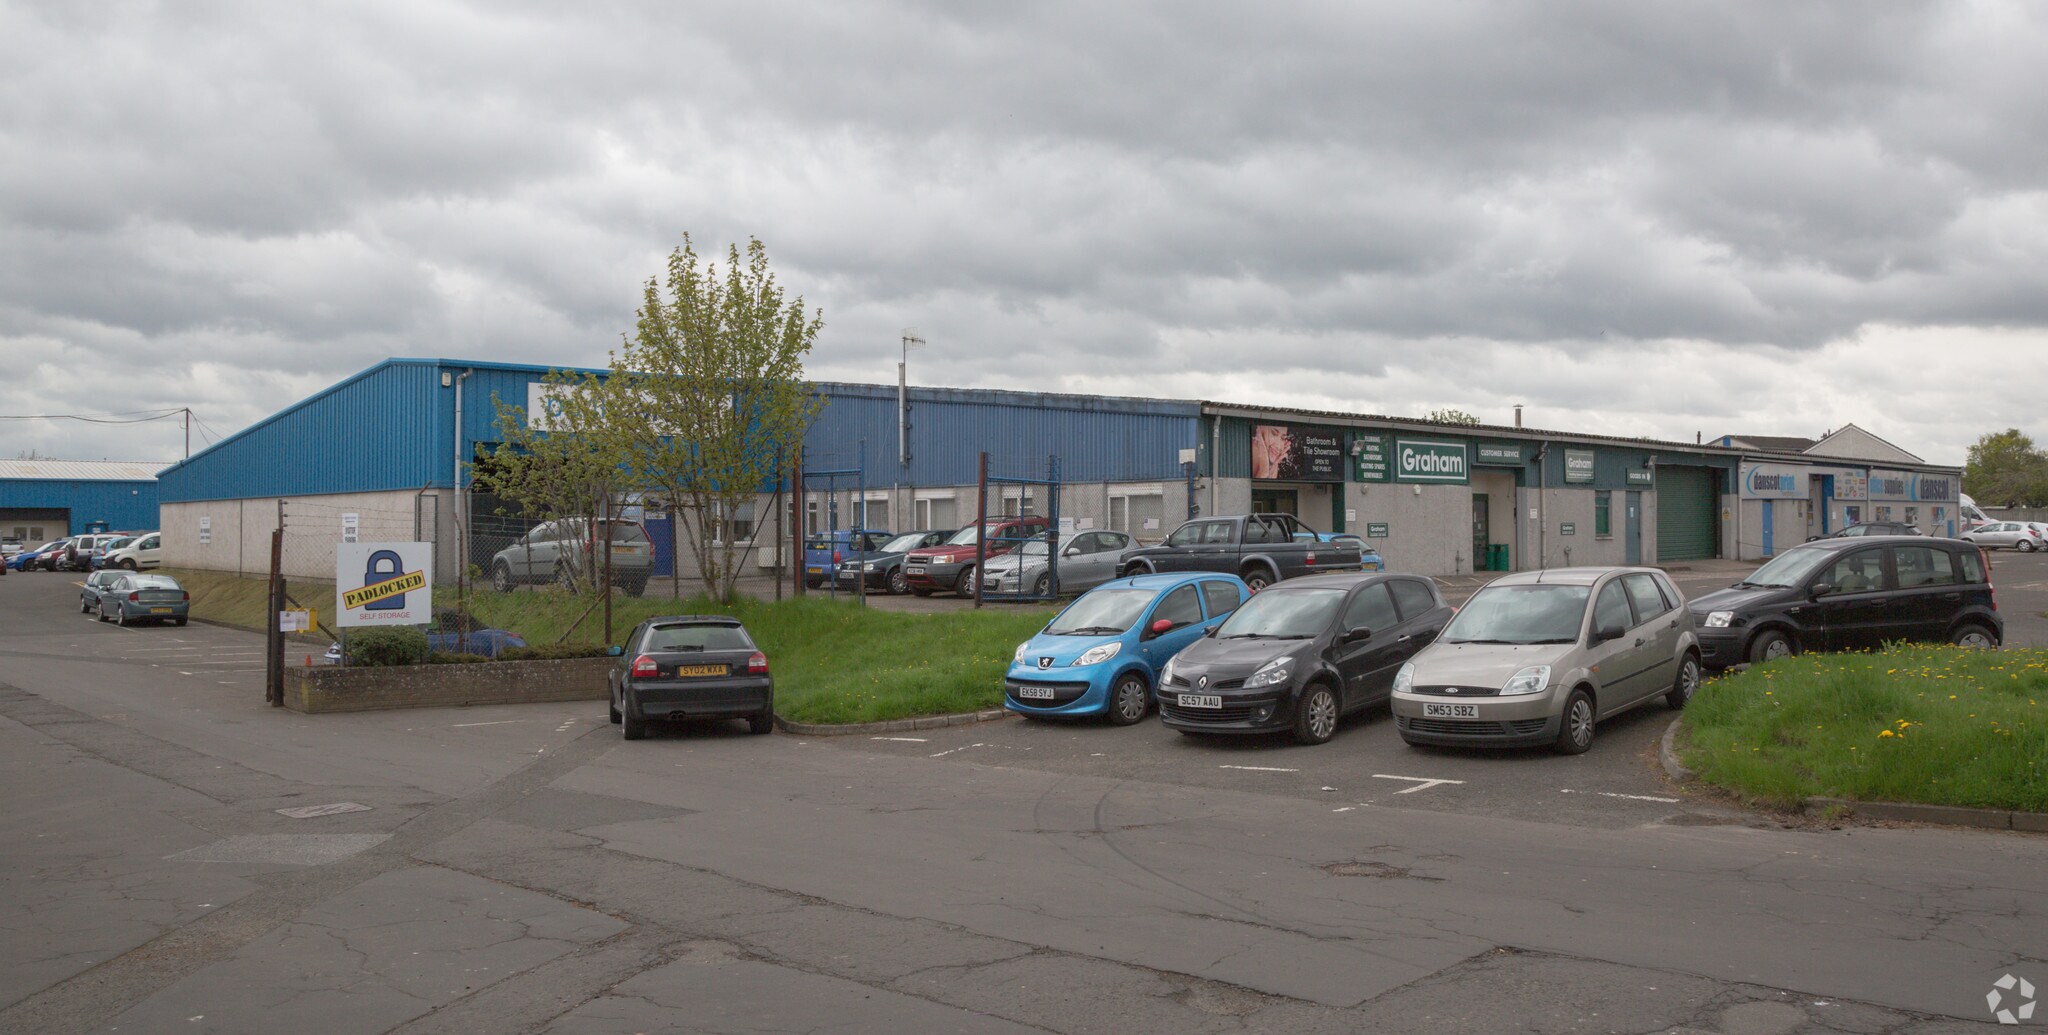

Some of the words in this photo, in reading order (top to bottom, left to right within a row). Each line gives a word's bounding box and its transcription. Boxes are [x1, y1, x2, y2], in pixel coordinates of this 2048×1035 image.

[1306, 436, 1331, 445] Bathroom
[1332, 438, 1336, 446] &
[1303, 446, 1313, 455] Tile
[1314, 447, 1340, 455] Showroom
[1480, 449, 1502, 457] CUSTOMER
[1503, 450, 1519, 458] SERVICE
[1402, 448, 1462, 472] Graham
[1568, 457, 1591, 469] Graham
[1884, 477, 1903, 496] supplies
[1921, 474, 1948, 500] danscot
[346, 574, 422, 606] PADLOCKED
[683, 666, 705, 675] SY02
[707, 665, 723, 673] WXA
[1022, 687, 1038, 696] EK58
[1039, 688, 1052, 697] SYJ
[1181, 696, 1201, 706] SC57
[1204, 697, 1219, 706] AAU
[1427, 704, 1452, 716] SM53
[1454, 705, 1474, 717] SBZ
